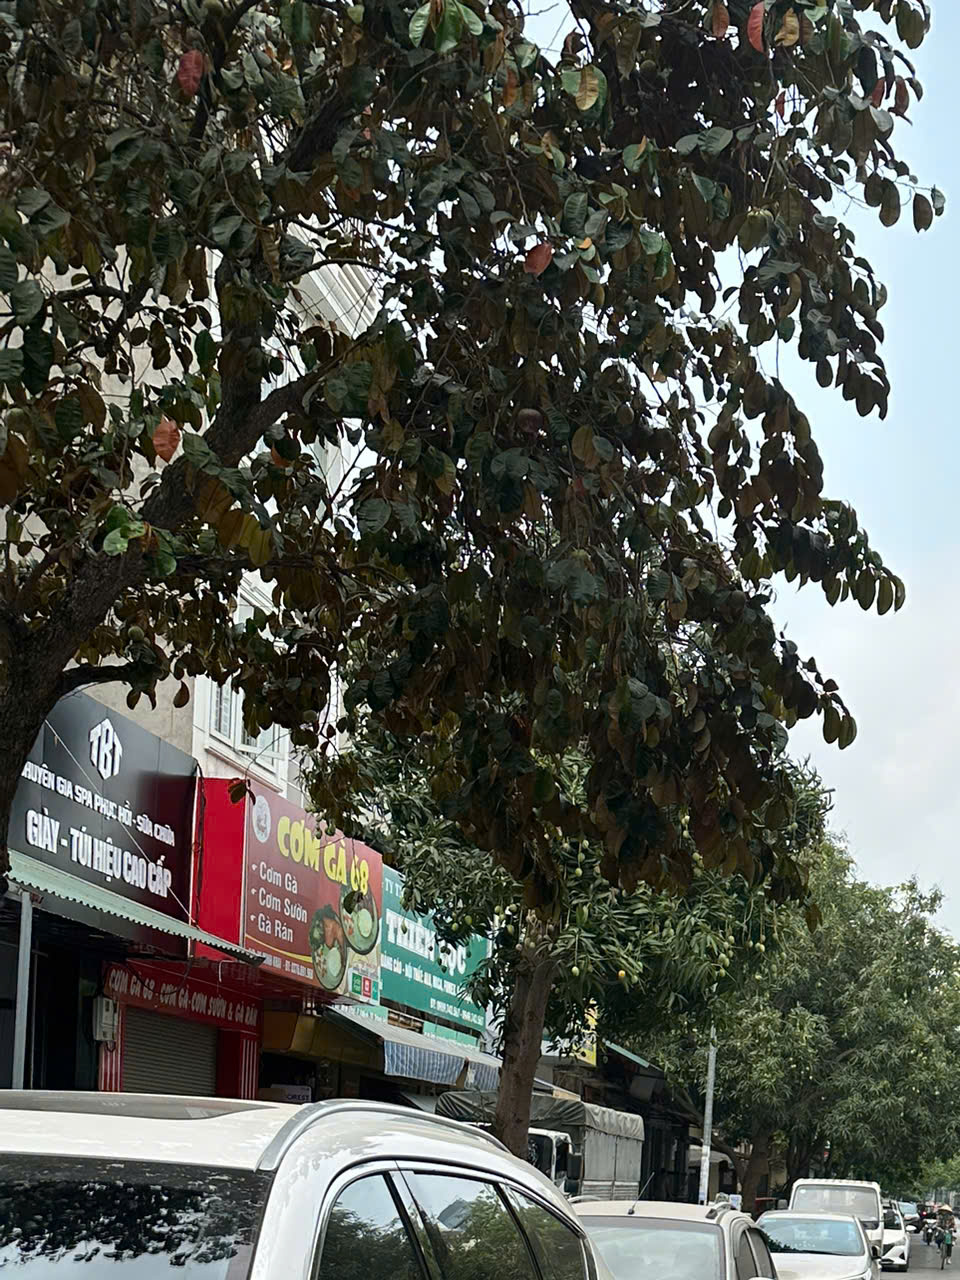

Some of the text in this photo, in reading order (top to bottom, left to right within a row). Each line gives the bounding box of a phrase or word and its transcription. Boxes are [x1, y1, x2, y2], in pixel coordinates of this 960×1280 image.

[89, 718, 123, 780] TBT
[21, 761, 55, 791] HUYÊN
[56, 776, 74, 800] GIA
[74, 784, 93, 809] SPA
[26, 807, 60, 854] GIÀY
[69, 826, 93, 868] TÚI
[92, 836, 123, 882] HIỆU
[122, 851, 147, 890] CAO
[147, 855, 172, 898] CẤP
[277, 815, 321, 872] CƠM
[323, 839, 348, 886] GÀ
[259, 861, 298, 894] Cơm Gà
[257, 913, 294, 943] Gà Rán
[258, 887, 308, 924] Cơm Sườn
